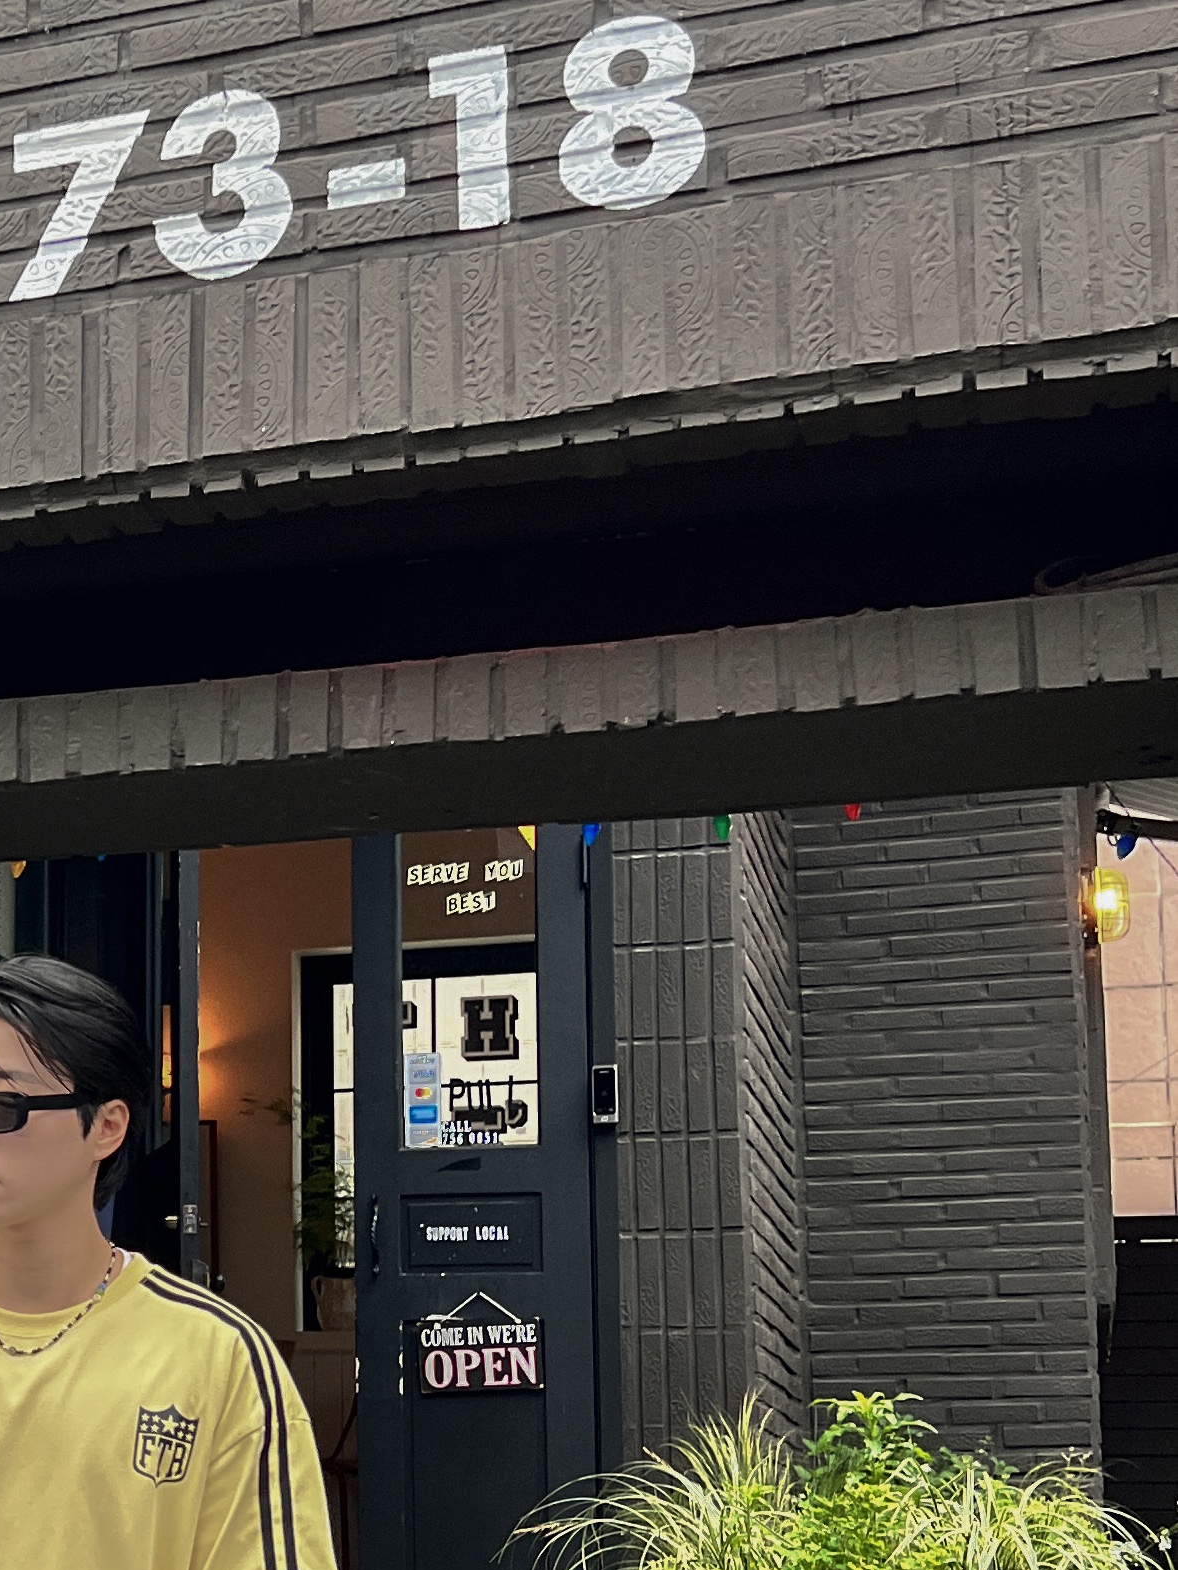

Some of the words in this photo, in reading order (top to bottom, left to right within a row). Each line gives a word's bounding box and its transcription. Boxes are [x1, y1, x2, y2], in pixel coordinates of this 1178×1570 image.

[409, 863, 467, 883] SERVE
[487, 861, 522, 879] YOU
[448, 893, 493, 912] BEST
[442, 1120, 473, 1133] CALL
[426, 1225, 469, 1242] SUPPORT
[475, 1225, 510, 1241] LOCAL
[421, 1327, 465, 1348] COME
[467, 1326, 484, 1346] IN
[487, 1323, 538, 1344] WE'RE
[424, 1346, 538, 1389] OPEN
